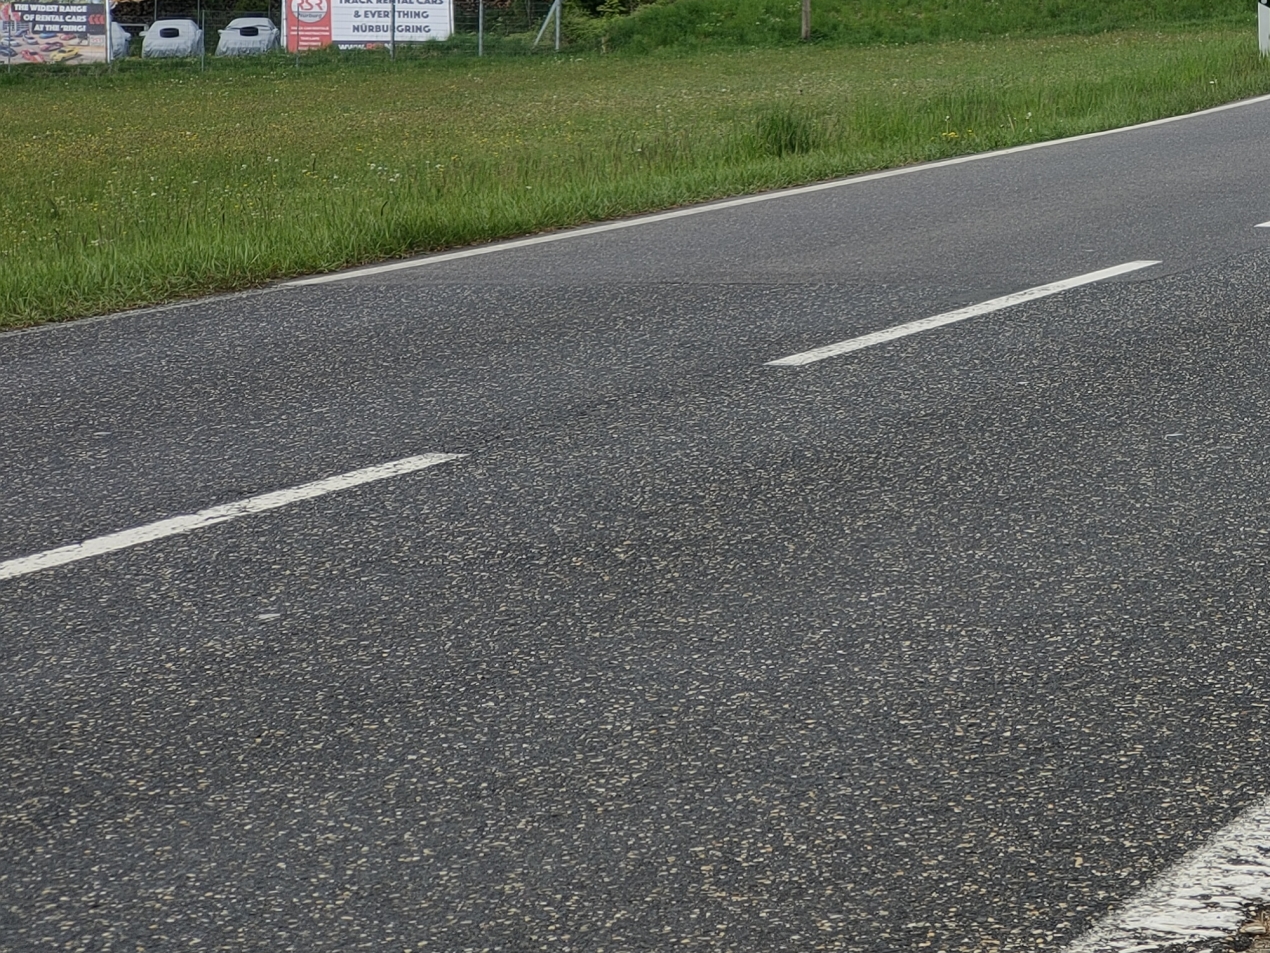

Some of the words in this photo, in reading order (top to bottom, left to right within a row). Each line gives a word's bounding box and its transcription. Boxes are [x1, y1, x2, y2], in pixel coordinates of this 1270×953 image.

[30, 4, 58, 12] WIDEST
[59, 5, 87, 13] RANGE
[36, 14, 64, 22] RENTAL
[353, 10, 361, 19] &
[364, 10, 429, 19] EVERTHING
[45, 24, 60, 32] THE
[352, 23, 431, 33] NÜRBUGRING
